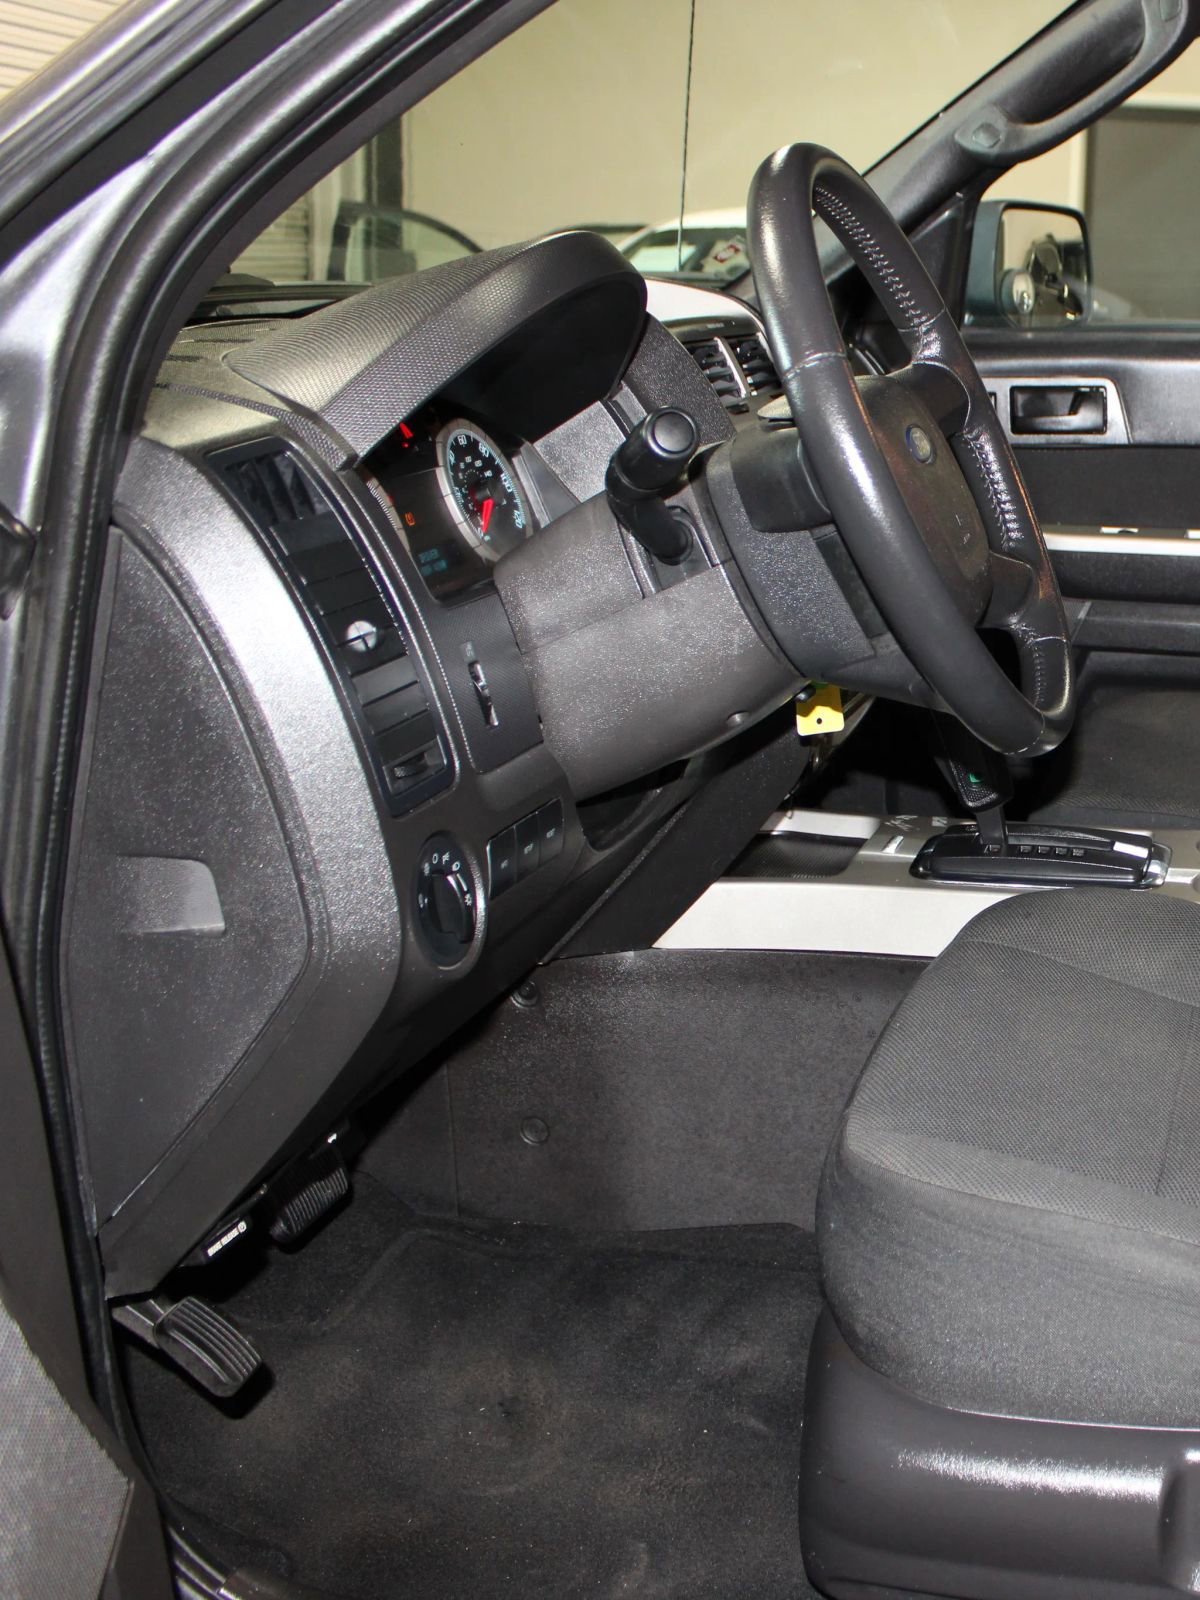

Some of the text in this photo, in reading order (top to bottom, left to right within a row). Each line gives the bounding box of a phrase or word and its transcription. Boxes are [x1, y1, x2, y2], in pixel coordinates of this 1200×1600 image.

[457, 434, 467, 446] 60
[478, 442, 489, 458] 80
[500, 473, 513, 493] 100
[513, 510, 523, 529] 120
